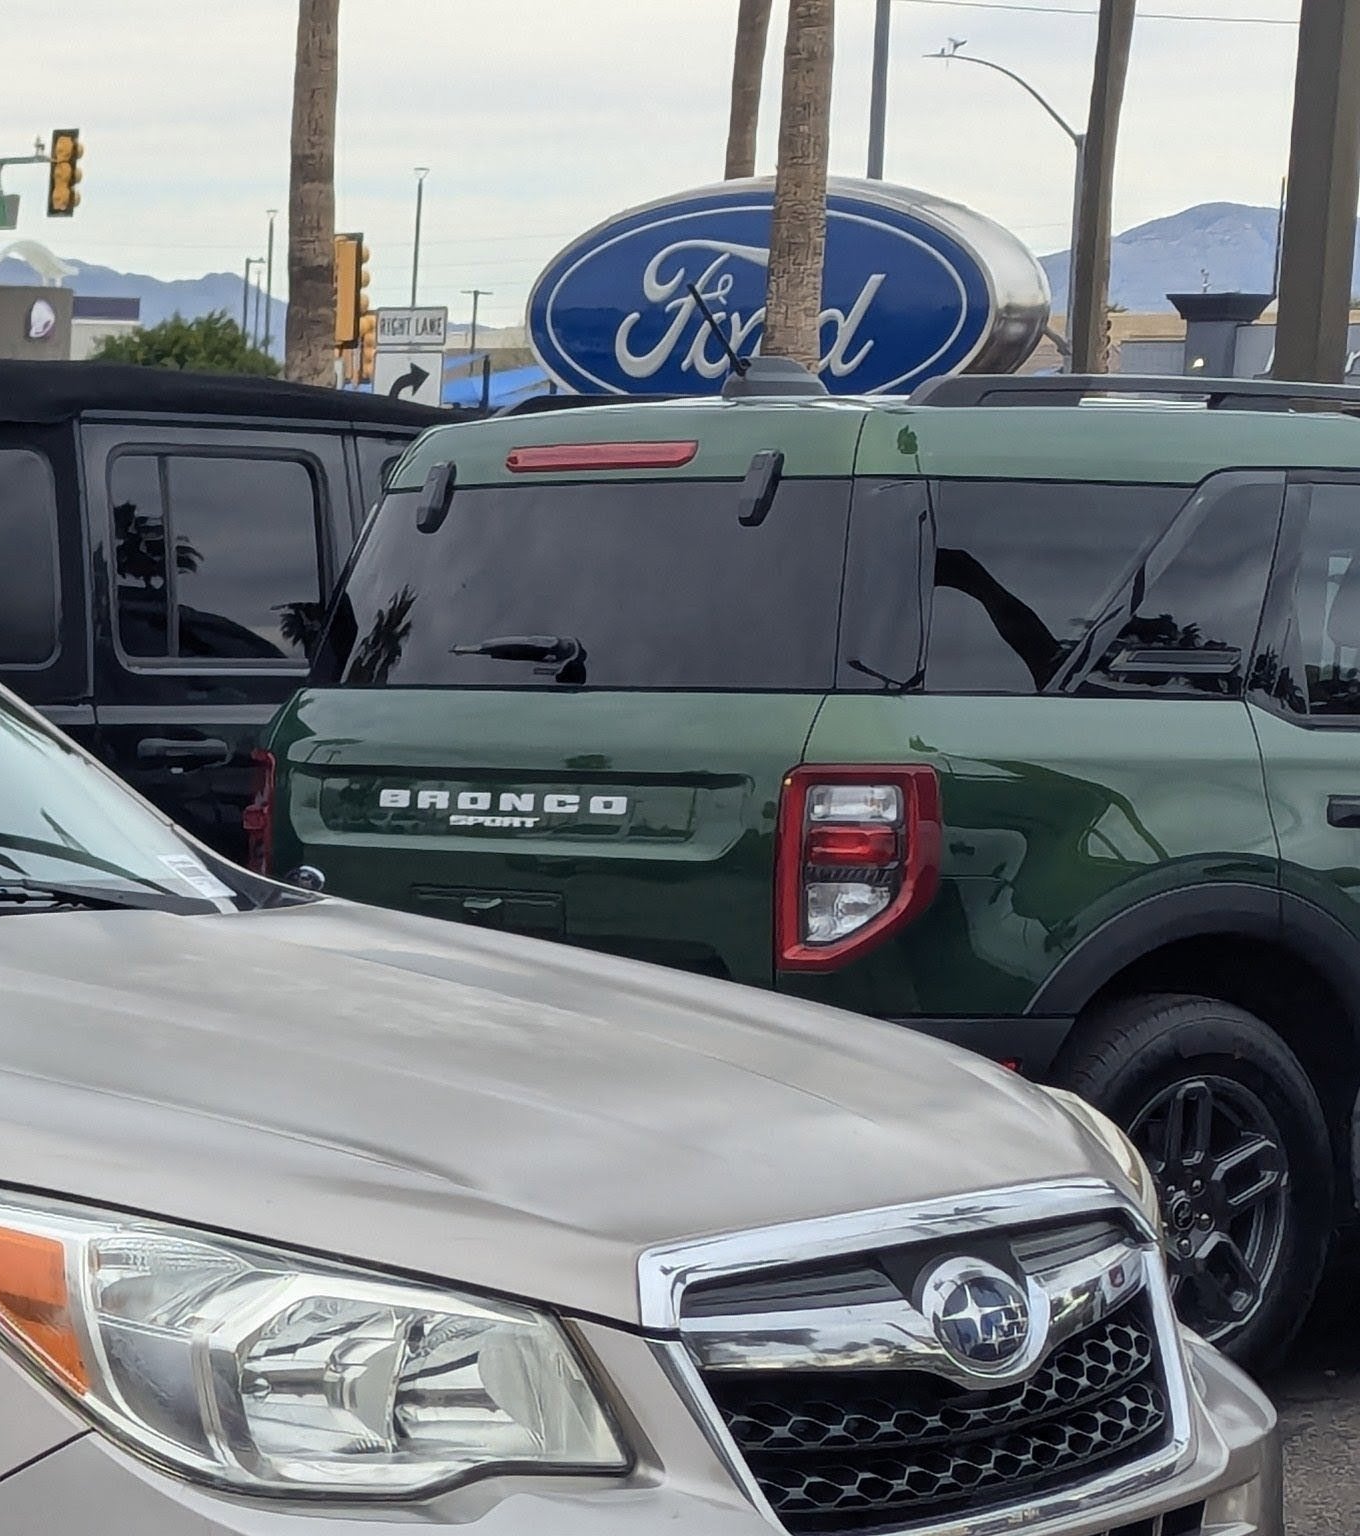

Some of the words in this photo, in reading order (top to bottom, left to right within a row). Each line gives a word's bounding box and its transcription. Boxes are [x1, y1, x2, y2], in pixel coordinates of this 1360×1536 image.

[615, 239, 887, 378] Ford
[380, 316, 412, 336] RIGHT
[415, 316, 442, 336] LANE
[379, 788, 628, 815] BRONCO
[449, 814, 541, 828] SPORT
